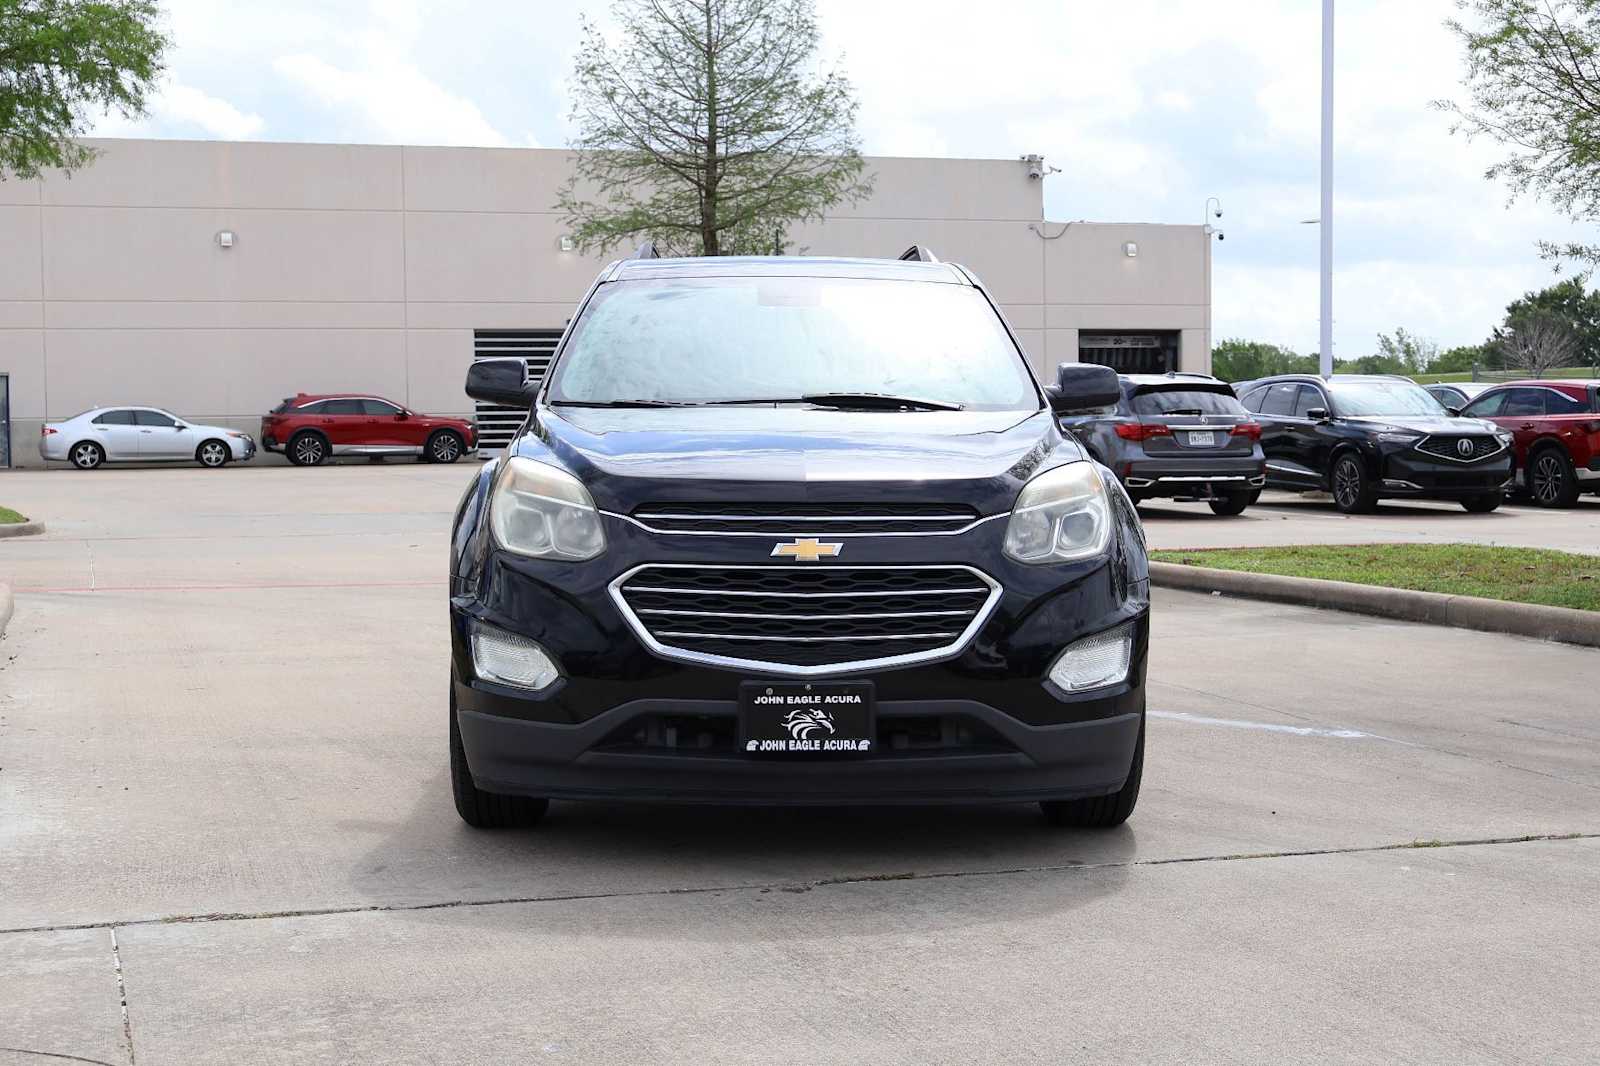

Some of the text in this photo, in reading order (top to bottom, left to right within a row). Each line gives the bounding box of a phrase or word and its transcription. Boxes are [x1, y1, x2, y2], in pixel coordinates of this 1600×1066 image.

[753, 695, 862, 705] JOHN EAGLE ACURA
[759, 739, 858, 751] JOHN EAGLE ACURA
